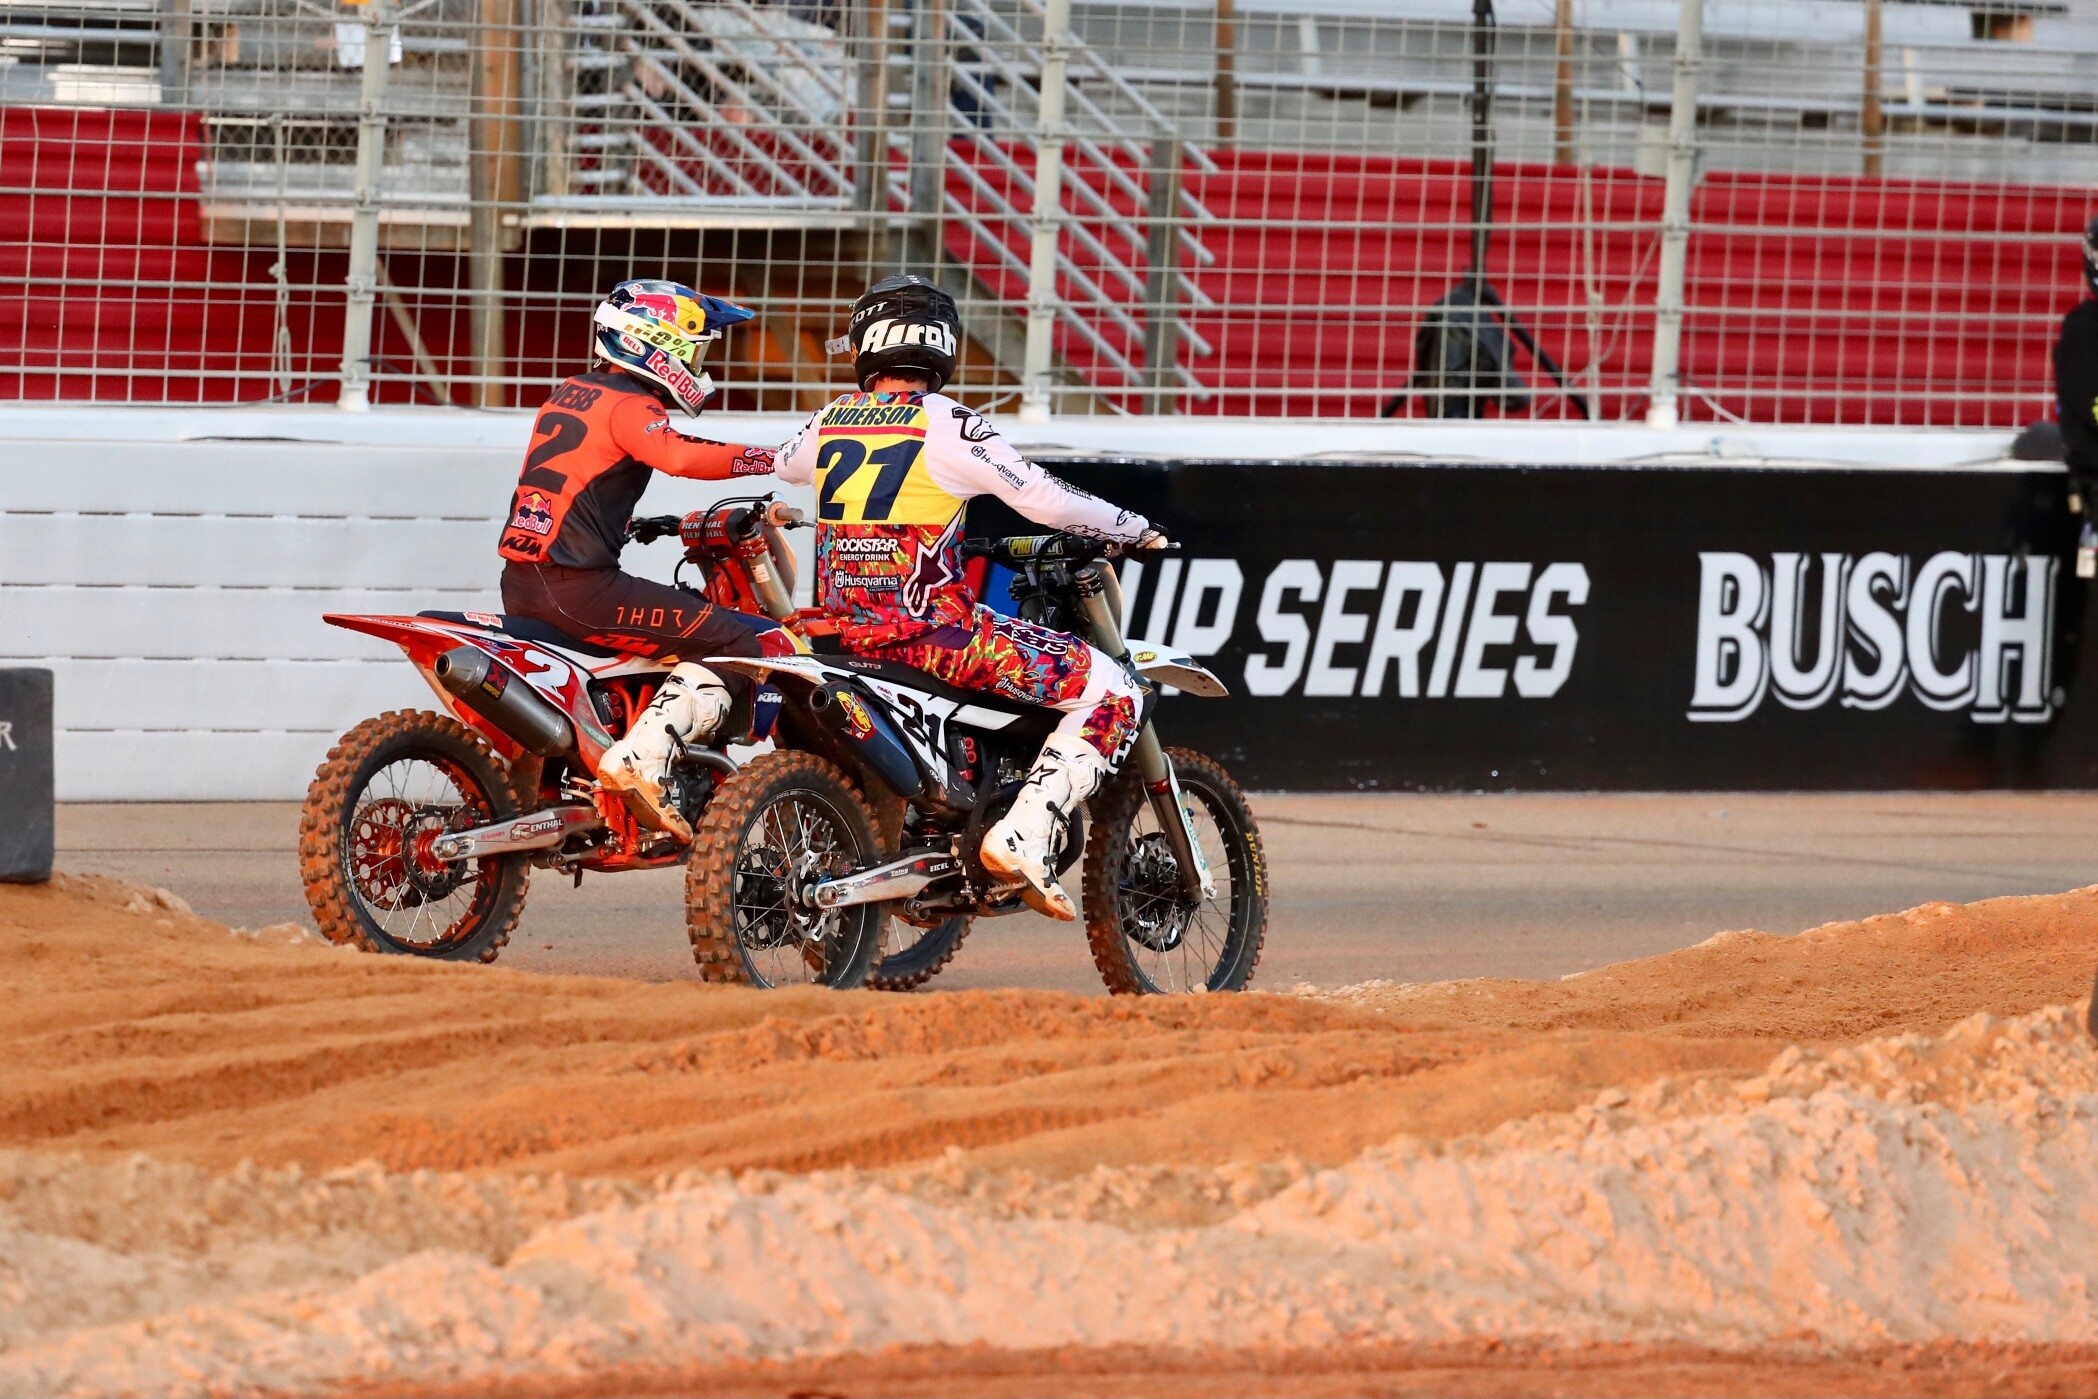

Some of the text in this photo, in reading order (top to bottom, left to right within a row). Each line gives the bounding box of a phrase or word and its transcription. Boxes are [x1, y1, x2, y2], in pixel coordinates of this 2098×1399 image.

[622, 335, 642, 353] BELL
[859, 319, 957, 357] Airoh
[546, 382, 603, 413] WEBB
[821, 405, 921, 427] ANDERSON
[519, 411, 589, 496] 2
[816, 438, 926, 521] 21
[502, 533, 544, 558] KTM
[835, 538, 898, 552] ROCKSTAR
[840, 553, 891, 562] ENERGY DRINK
[844, 574, 898, 588] Husqvarna
[617, 606, 683, 628] THOR
[1243, 559, 1591, 698] SERIES
[1686, 551, 2060, 723] BUSCH
[525, 649, 572, 704] 2
[757, 692, 783, 704] KTM
[897, 693, 942, 762] 21
[1245, 831, 1262, 897] DUNLOP
